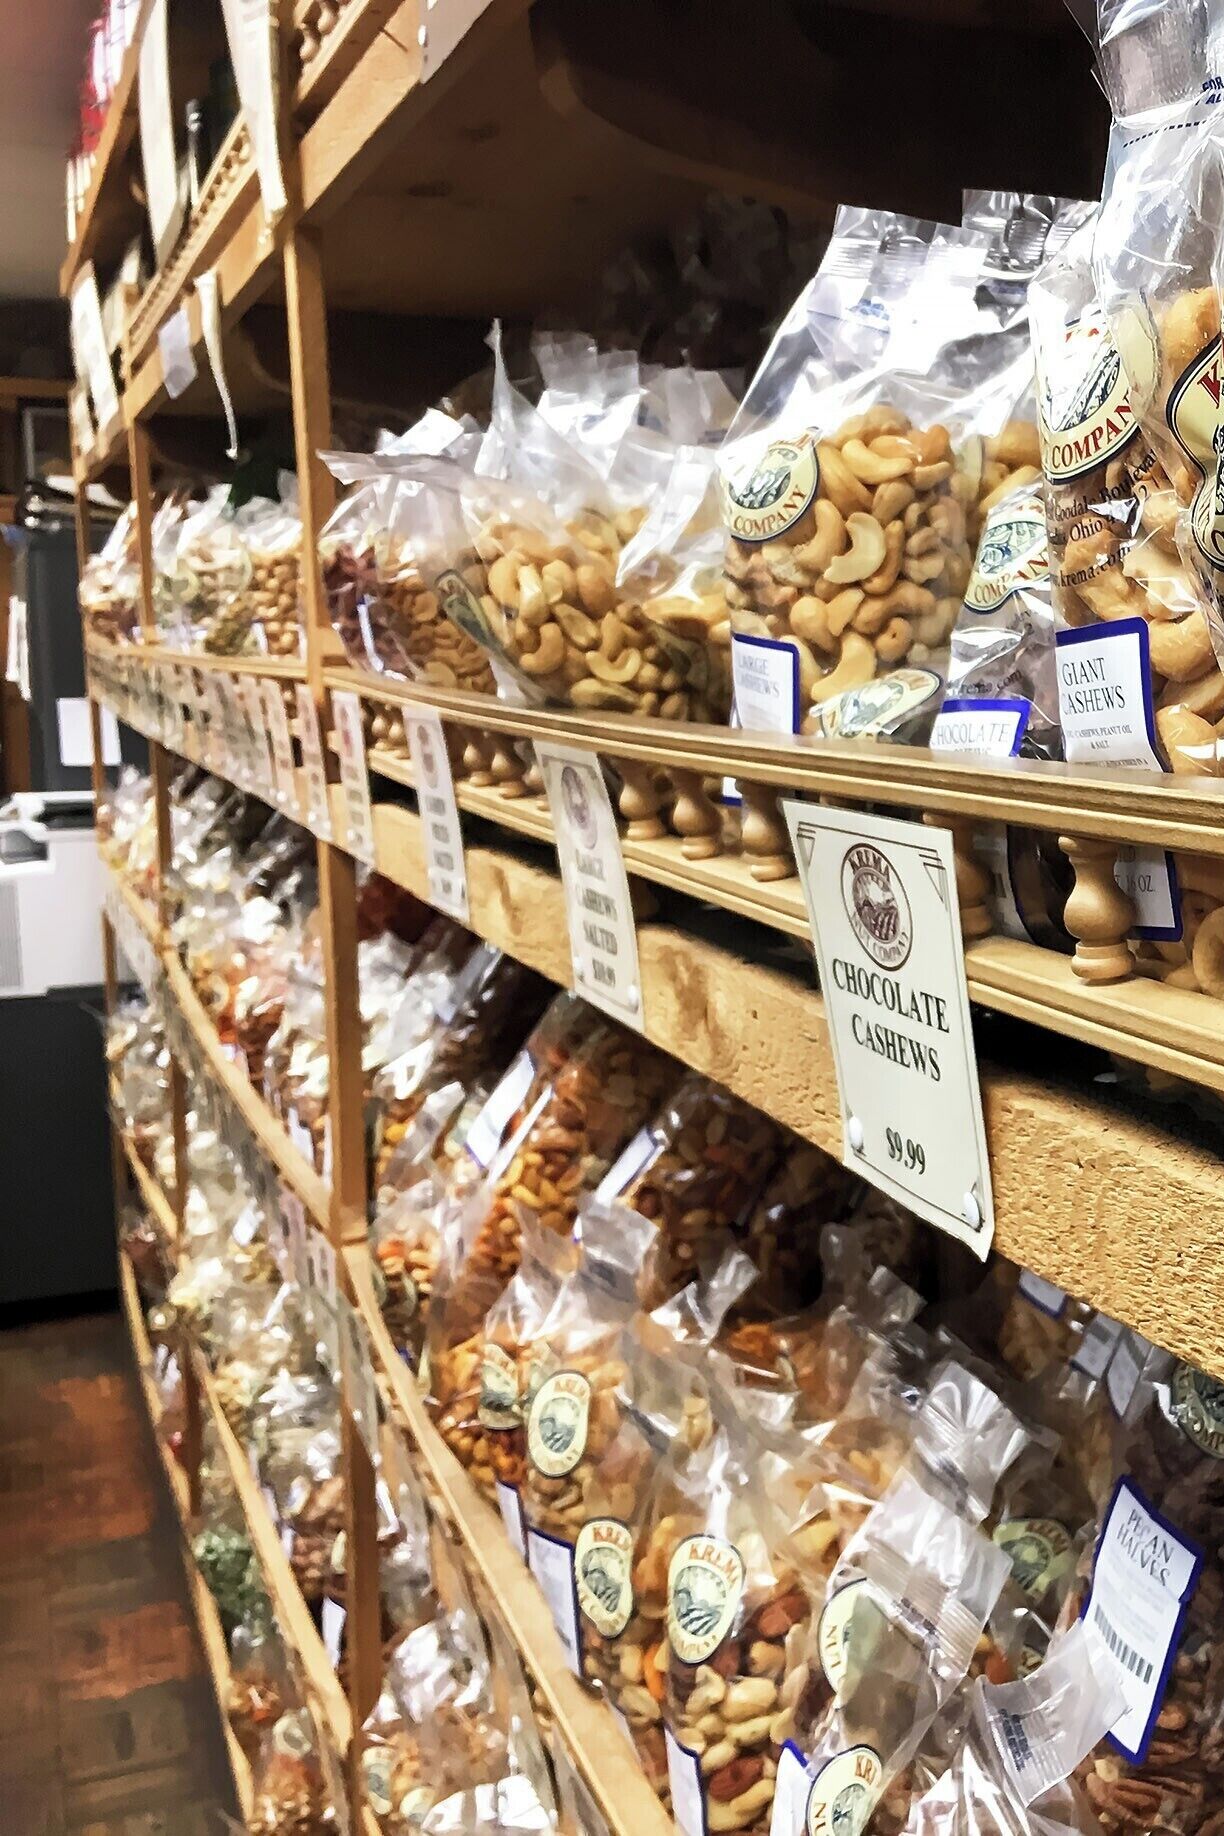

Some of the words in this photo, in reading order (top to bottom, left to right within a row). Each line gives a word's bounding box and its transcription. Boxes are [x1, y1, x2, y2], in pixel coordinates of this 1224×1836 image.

[1052, 396, 1133, 469] COMPAN
[1070, 518, 1103, 541] Ohio
[1062, 657, 1106, 687] GIANT
[847, 849, 891, 881] KREMA
[832, 957, 950, 1035] CHOCOLATE
[852, 1012, 942, 1083] CASHEWS
[886, 1126, 926, 1176] $9.99
[1127, 1508, 1175, 1564] PECAN
